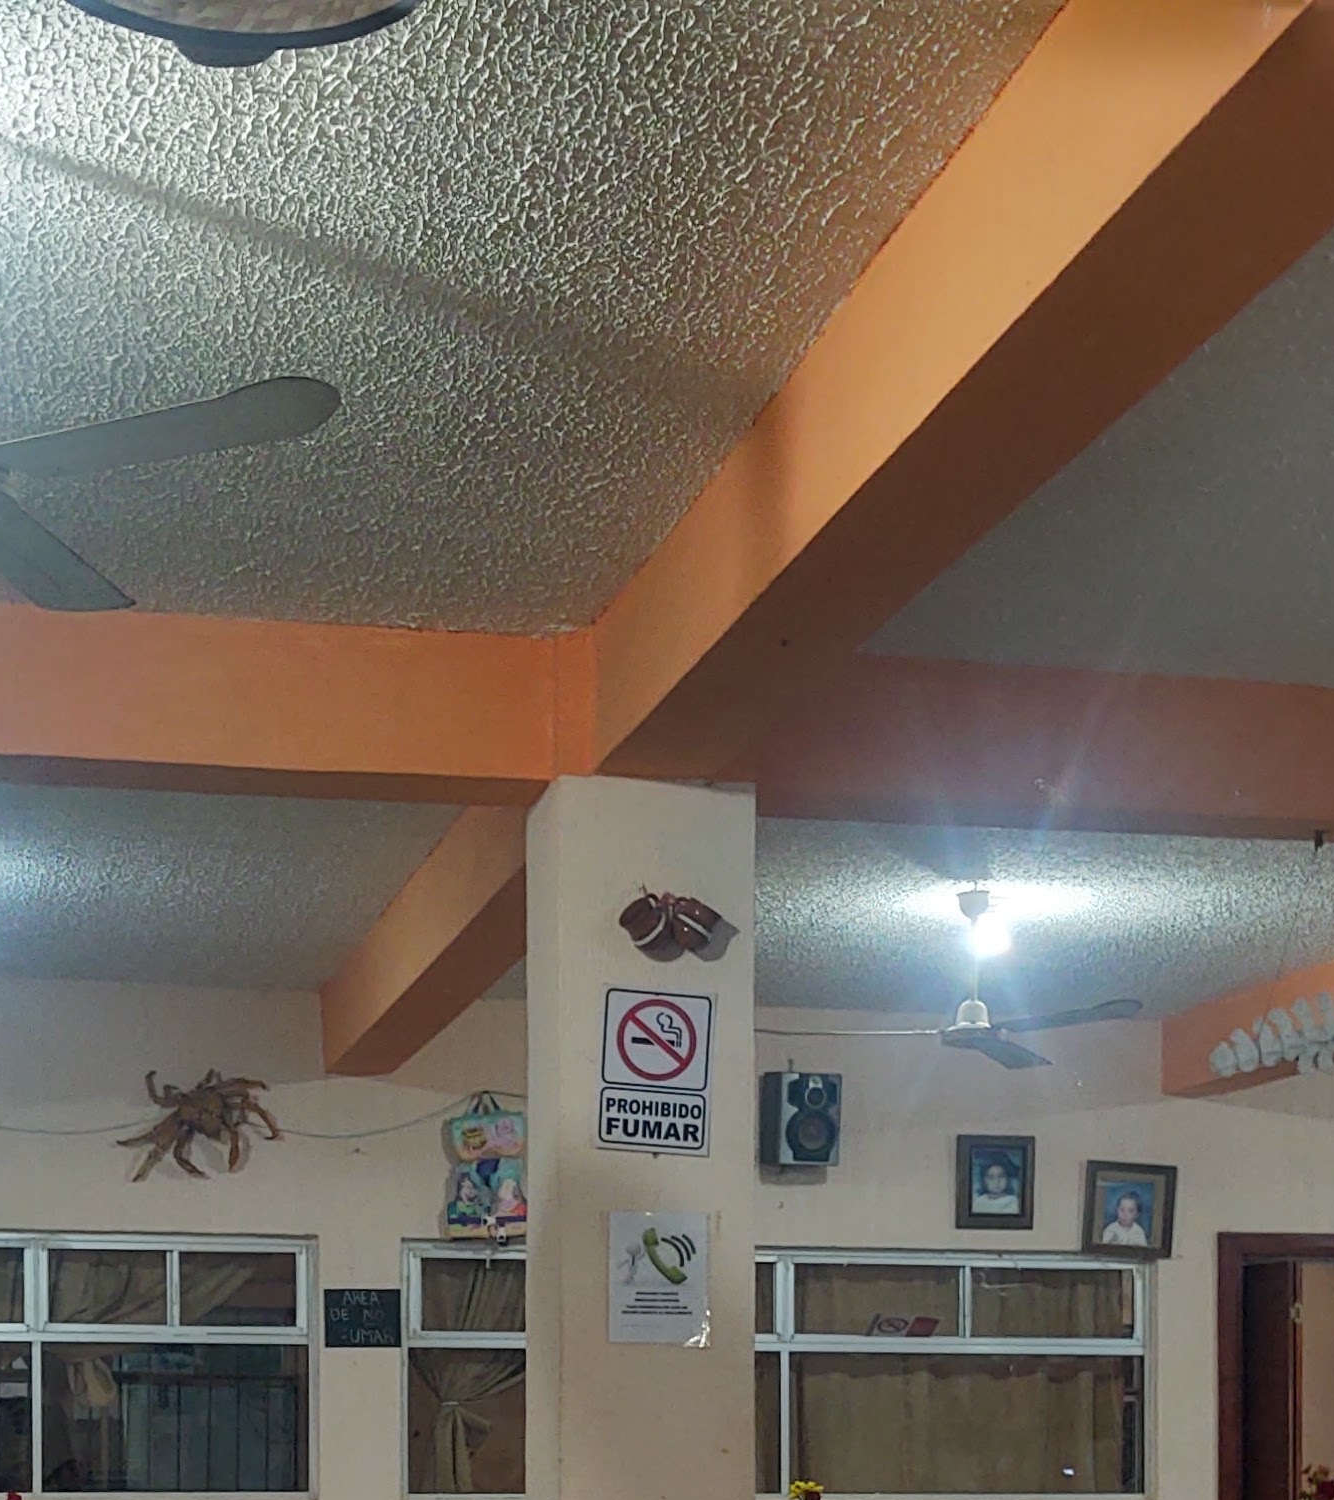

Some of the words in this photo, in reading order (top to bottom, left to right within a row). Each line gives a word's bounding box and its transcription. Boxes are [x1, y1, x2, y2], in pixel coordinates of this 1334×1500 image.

[605, 1096, 702, 1121] PROHIBIDO
[604, 1117, 700, 1143] FUMAR
[329, 1307, 350, 1322] DE
[363, 1308, 386, 1323] NO
